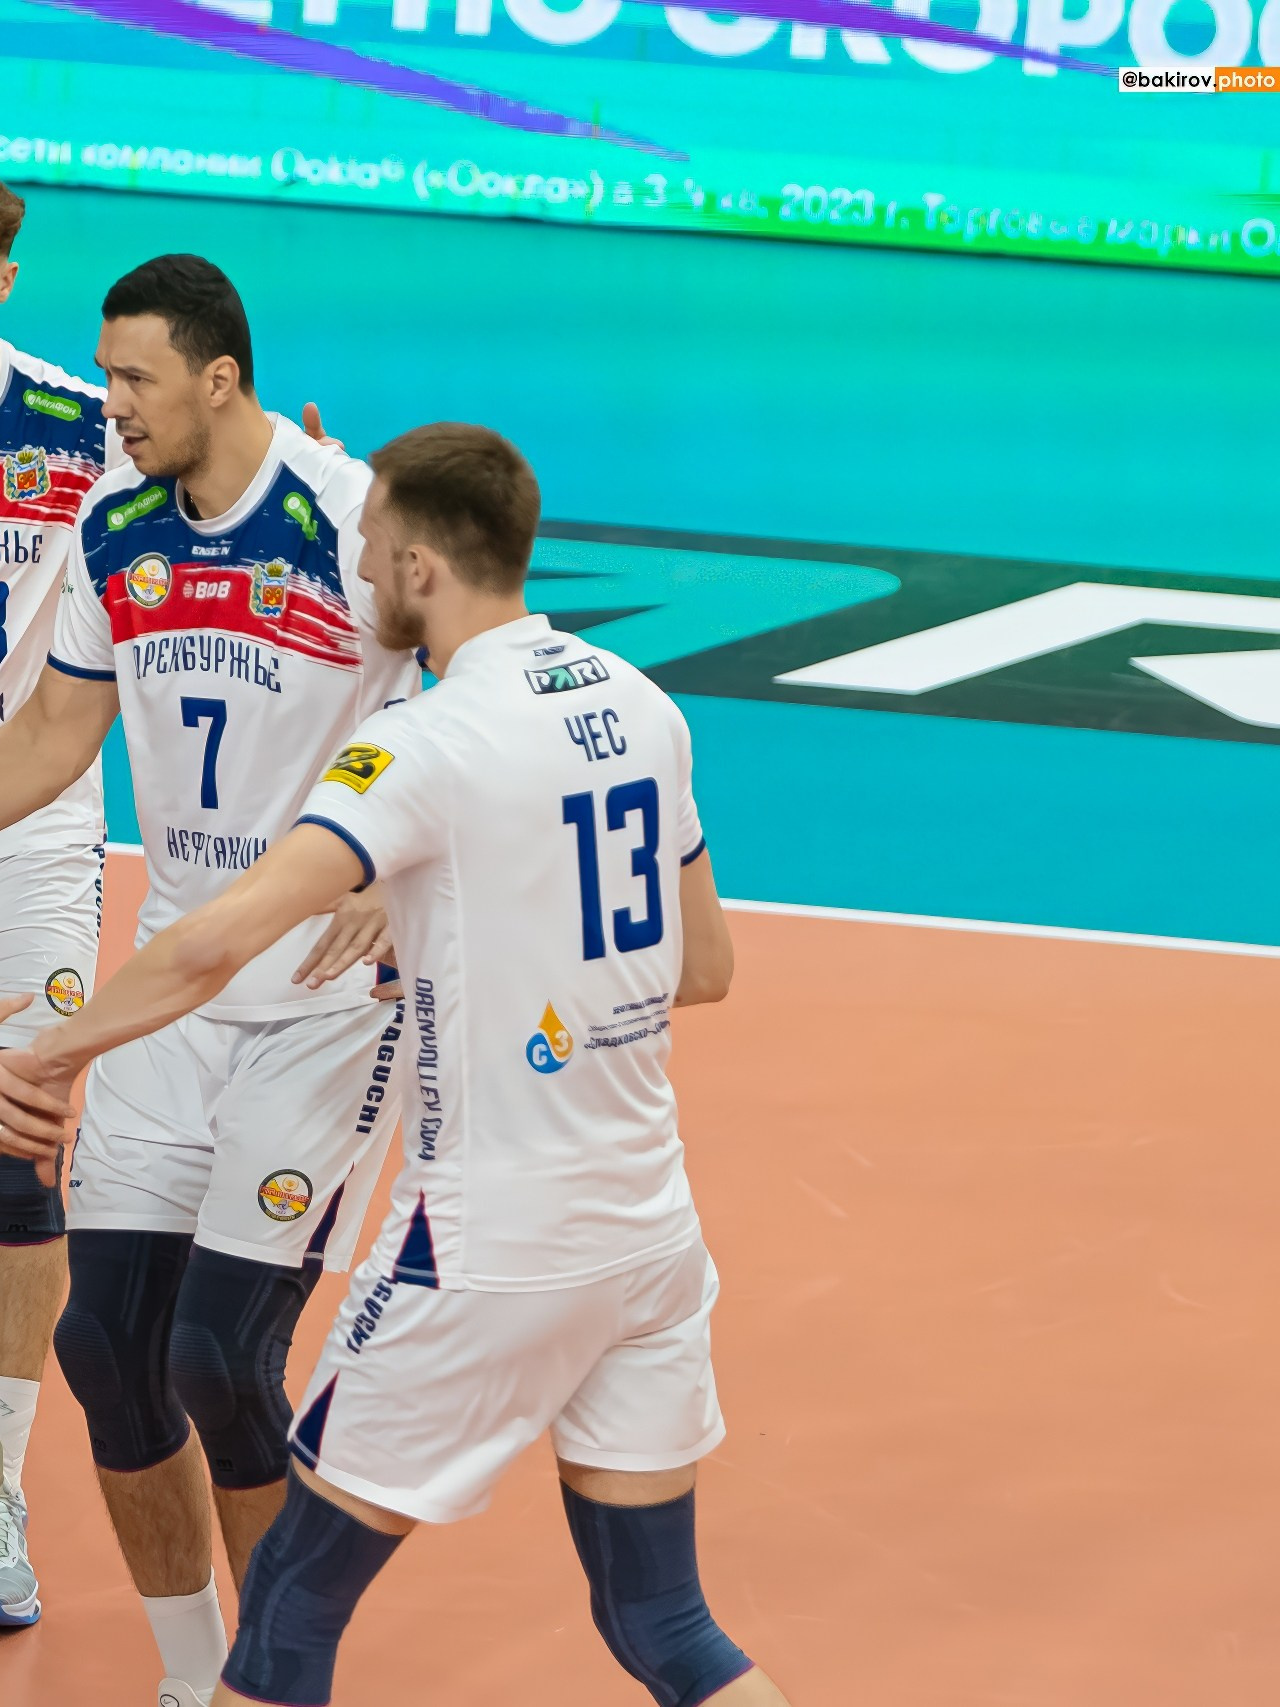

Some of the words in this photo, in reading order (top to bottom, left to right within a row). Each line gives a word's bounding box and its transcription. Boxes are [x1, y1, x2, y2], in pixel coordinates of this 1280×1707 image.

[180, 696, 228, 810] 7
[564, 708, 627, 762] ЧЕС
[562, 777, 664, 961] 13
[356, 1000, 405, 1134] MAGUCHI
